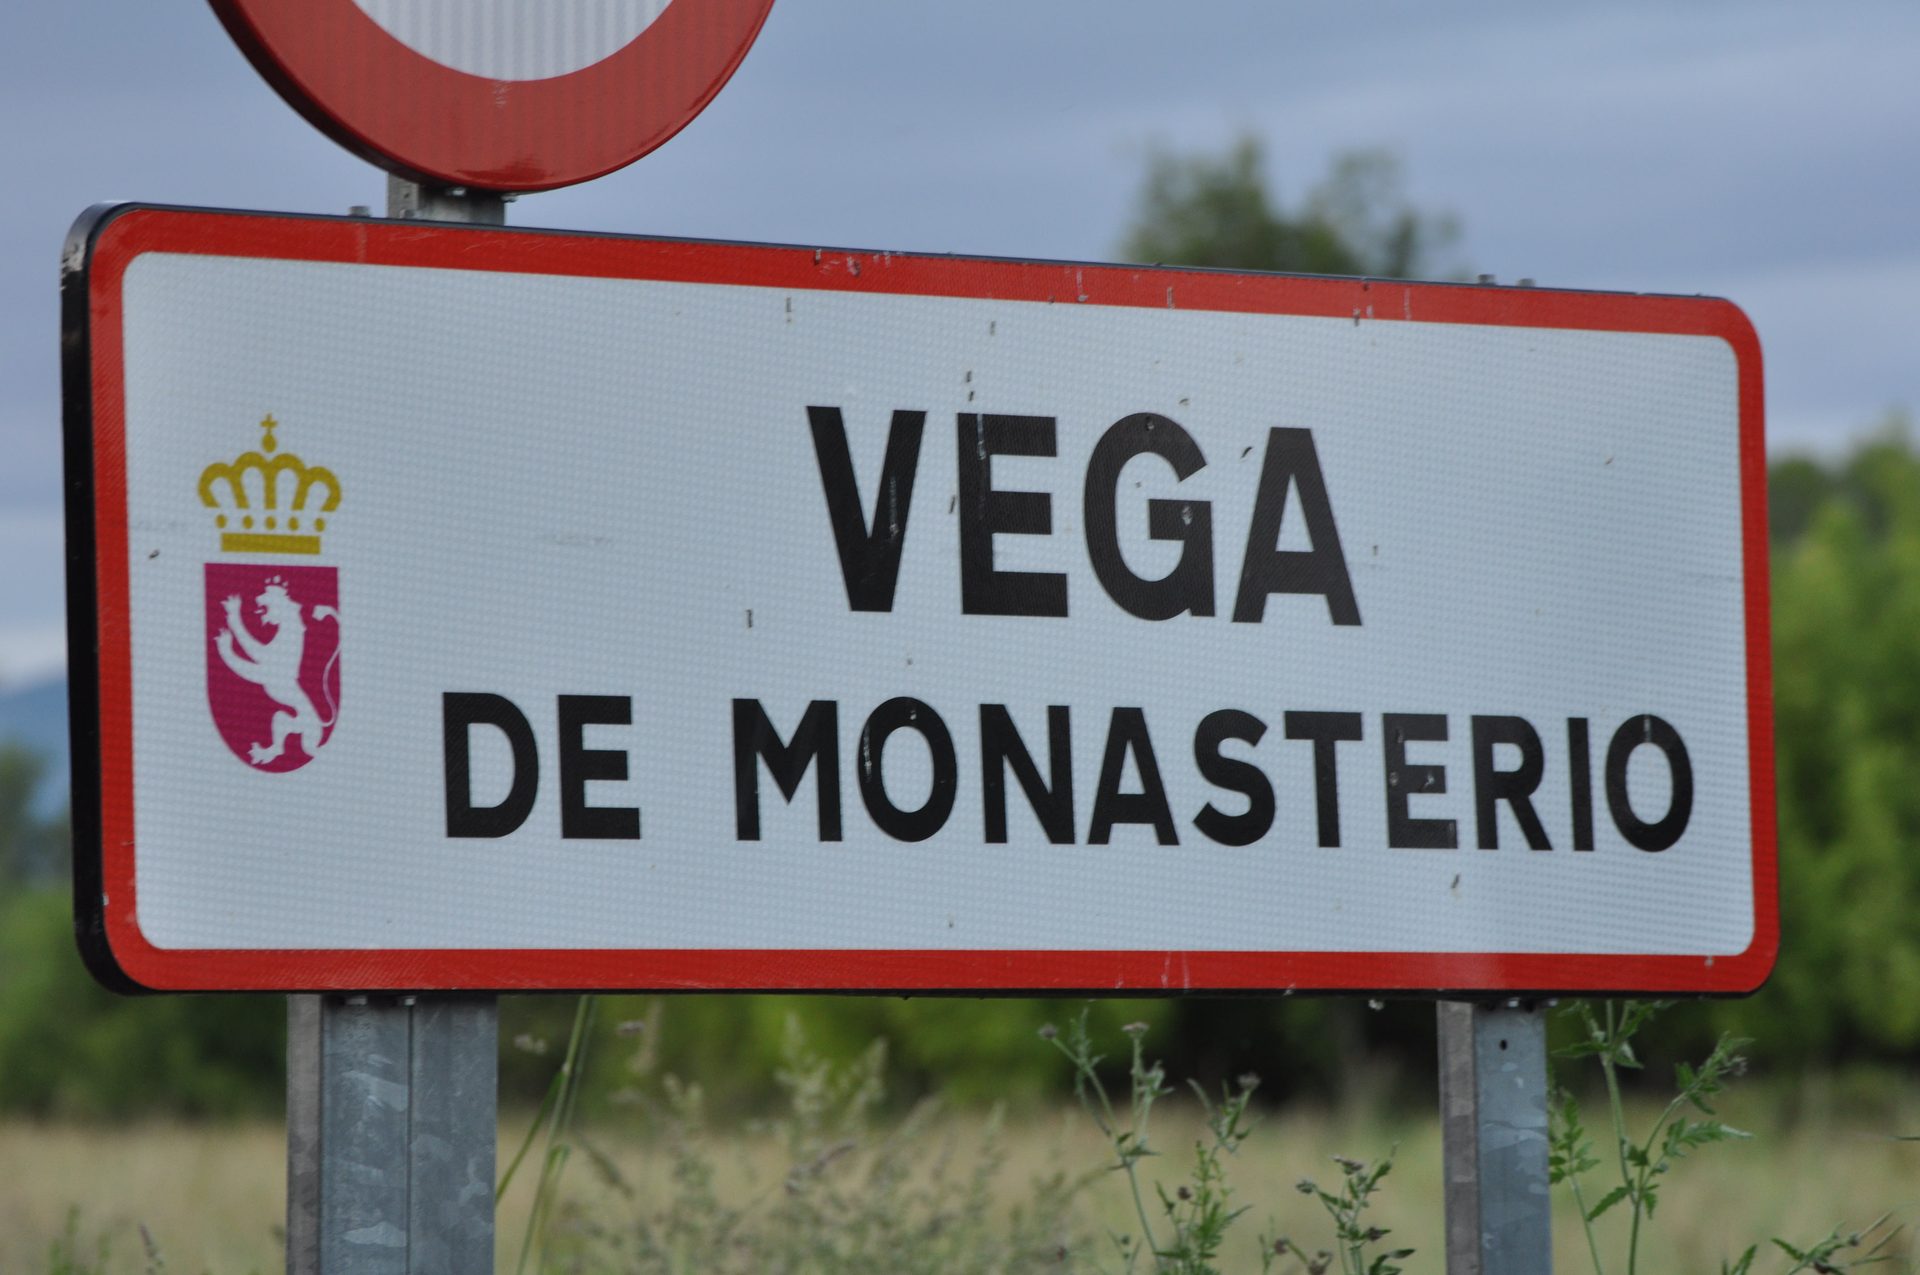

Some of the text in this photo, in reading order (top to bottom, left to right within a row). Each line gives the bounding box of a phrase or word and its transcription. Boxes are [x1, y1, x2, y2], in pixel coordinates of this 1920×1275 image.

[807, 405, 1362, 626] VEGA
[442, 691, 1694, 853] DE MONASTERIO
